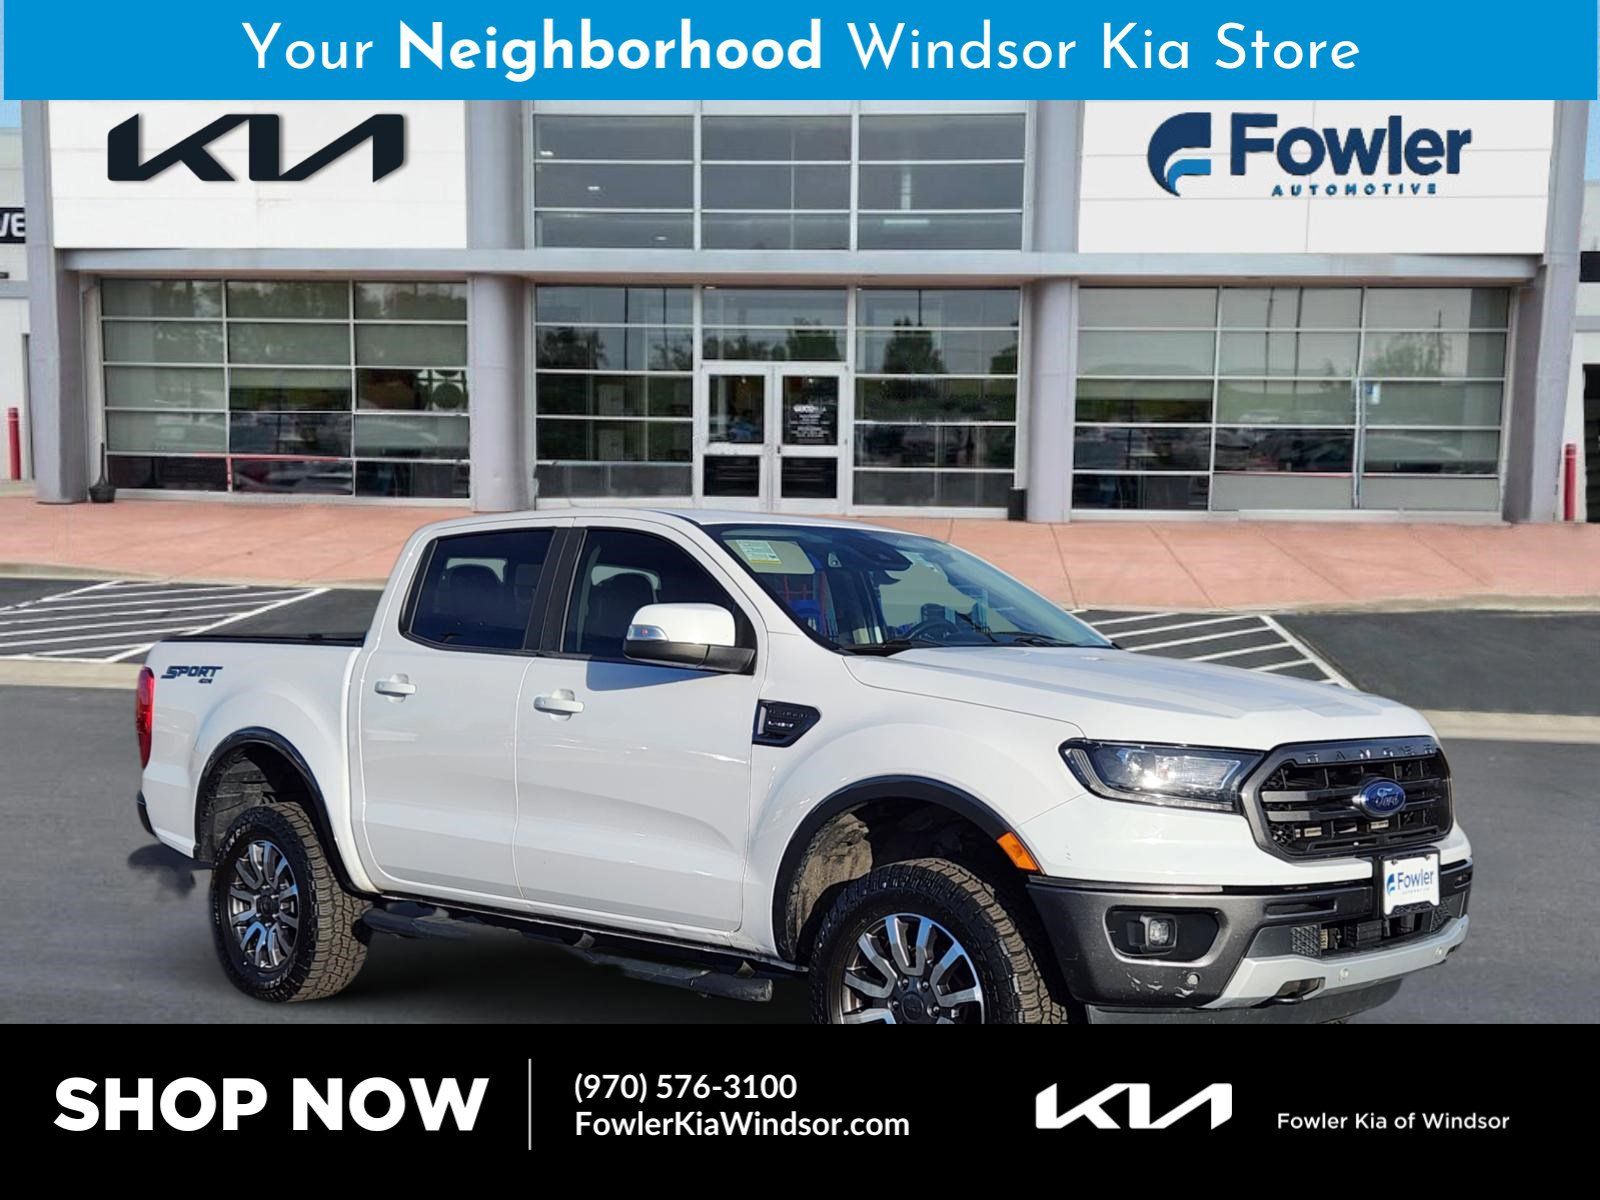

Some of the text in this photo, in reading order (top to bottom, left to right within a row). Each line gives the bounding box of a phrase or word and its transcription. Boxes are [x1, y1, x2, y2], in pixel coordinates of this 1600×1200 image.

[107, 113, 408, 184] KIA
[1229, 112, 1473, 177] Fowler
[1271, 182, 1438, 197] AUTOMOTIVE
[160, 665, 223, 679] SPORT
[1375, 787, 1400, 807] Ford
[1397, 868, 1434, 890] Fowler
